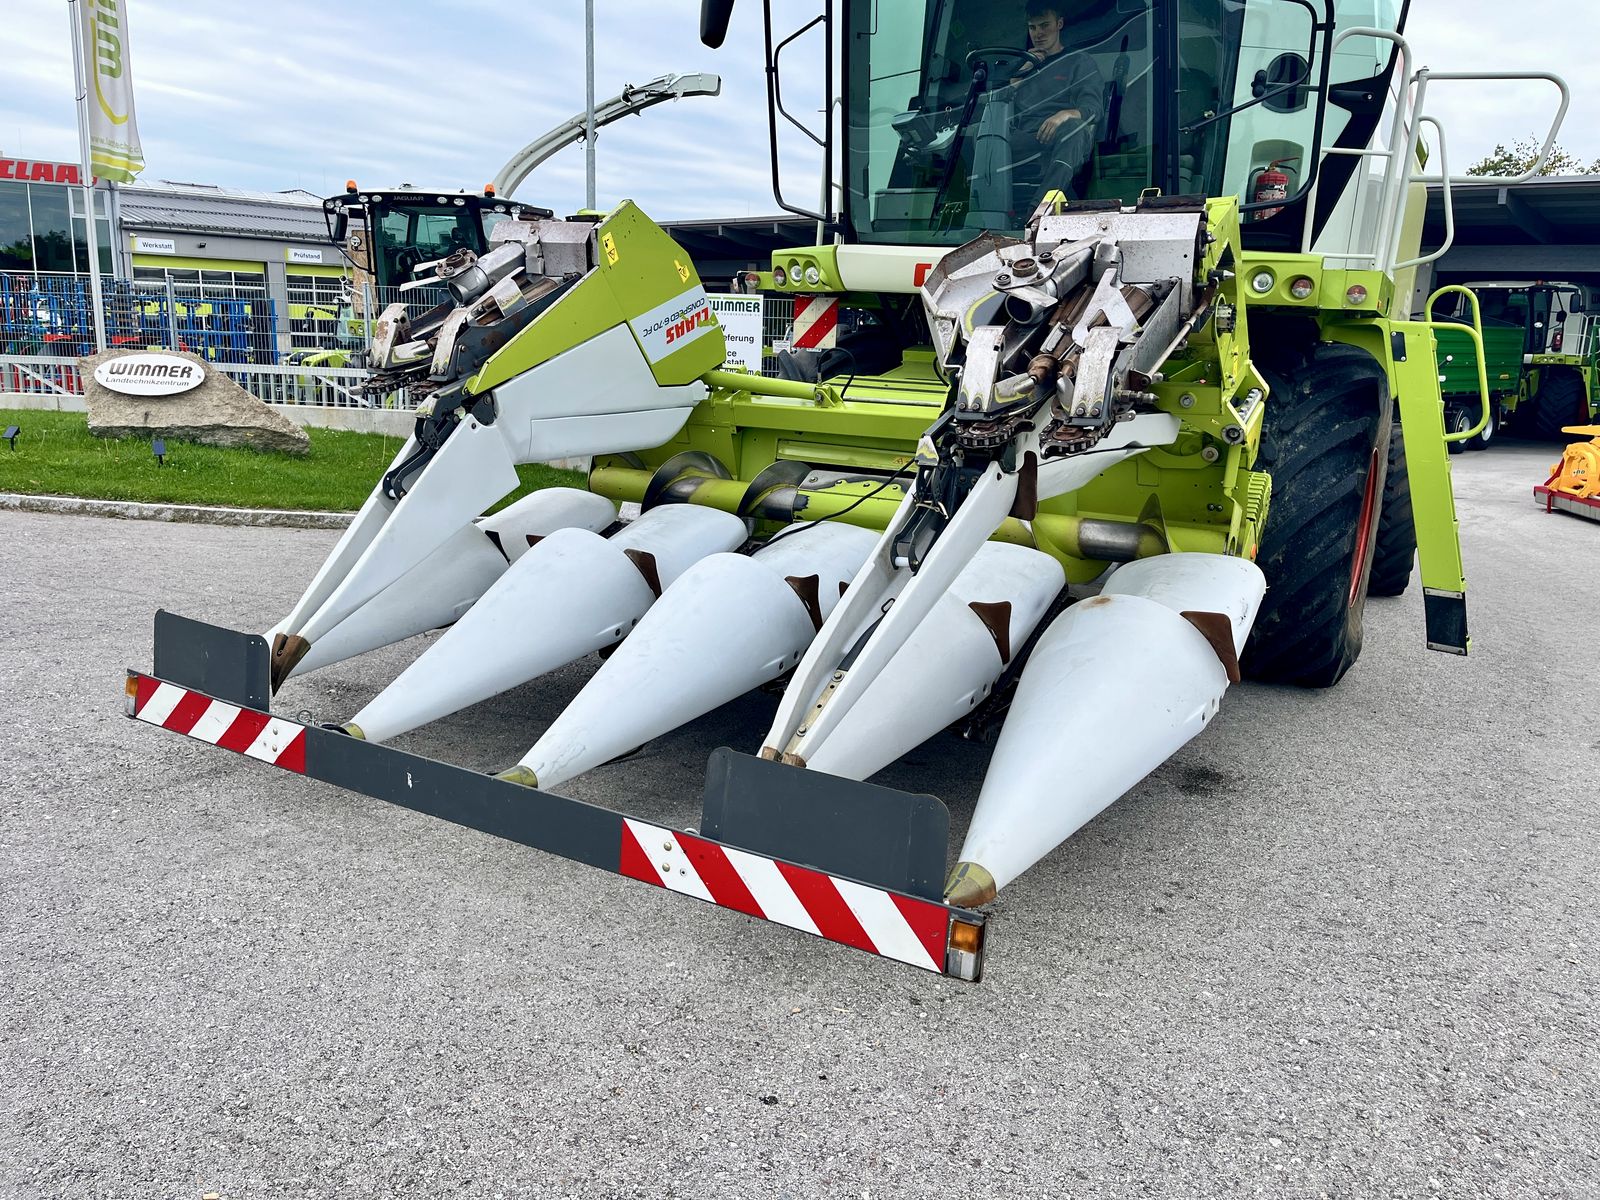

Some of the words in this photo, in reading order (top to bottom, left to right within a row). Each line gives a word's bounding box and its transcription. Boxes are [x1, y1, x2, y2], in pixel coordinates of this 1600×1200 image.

[0, 159, 98, 185] CLAA
[142, 241, 173, 250] Werkstatt
[293, 251, 321, 260] Prüfstand
[723, 333, 754, 344] eferung
[108, 362, 193, 379] WIMMER
[105, 376, 190, 387] Landtechnikzentrum
